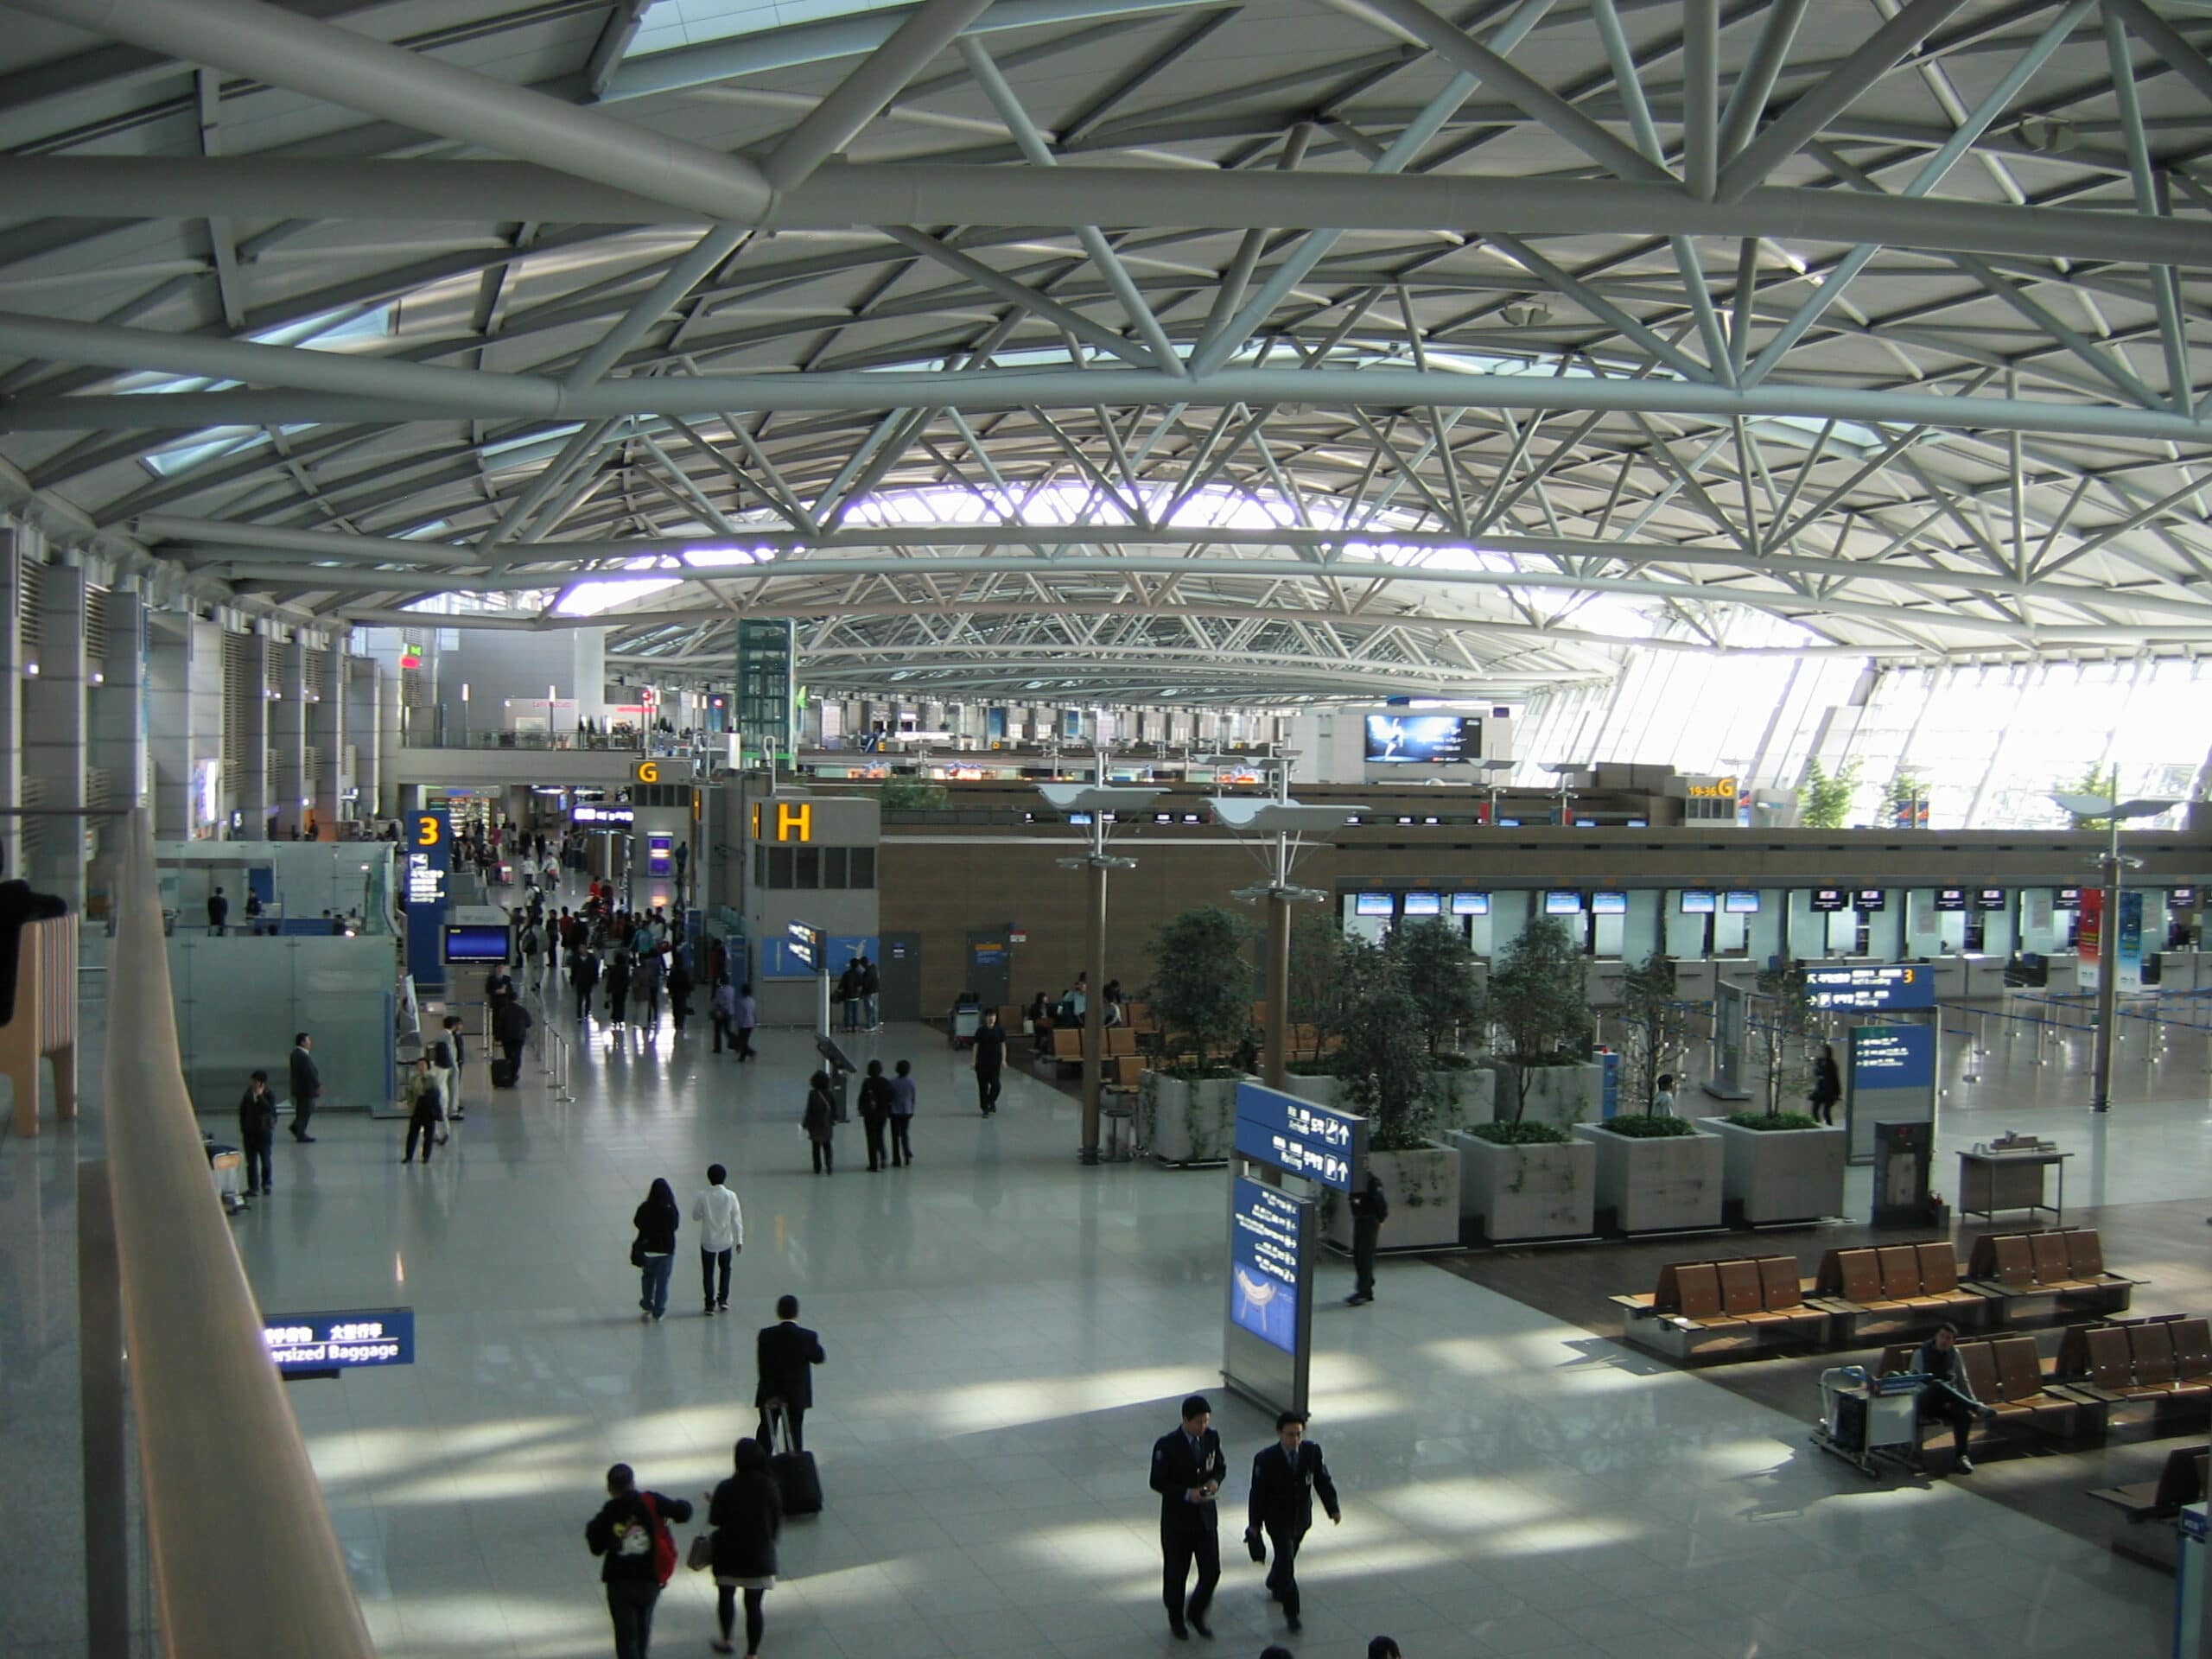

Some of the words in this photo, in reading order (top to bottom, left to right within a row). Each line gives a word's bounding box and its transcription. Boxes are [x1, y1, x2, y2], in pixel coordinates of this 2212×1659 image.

[639, 762, 658, 783] G
[1717, 779, 1733, 797] G
[418, 817, 439, 845] 3
[779, 803, 811, 842] H
[1903, 969, 1915, 984] 3
[328, 1344, 399, 1363] Baggage
